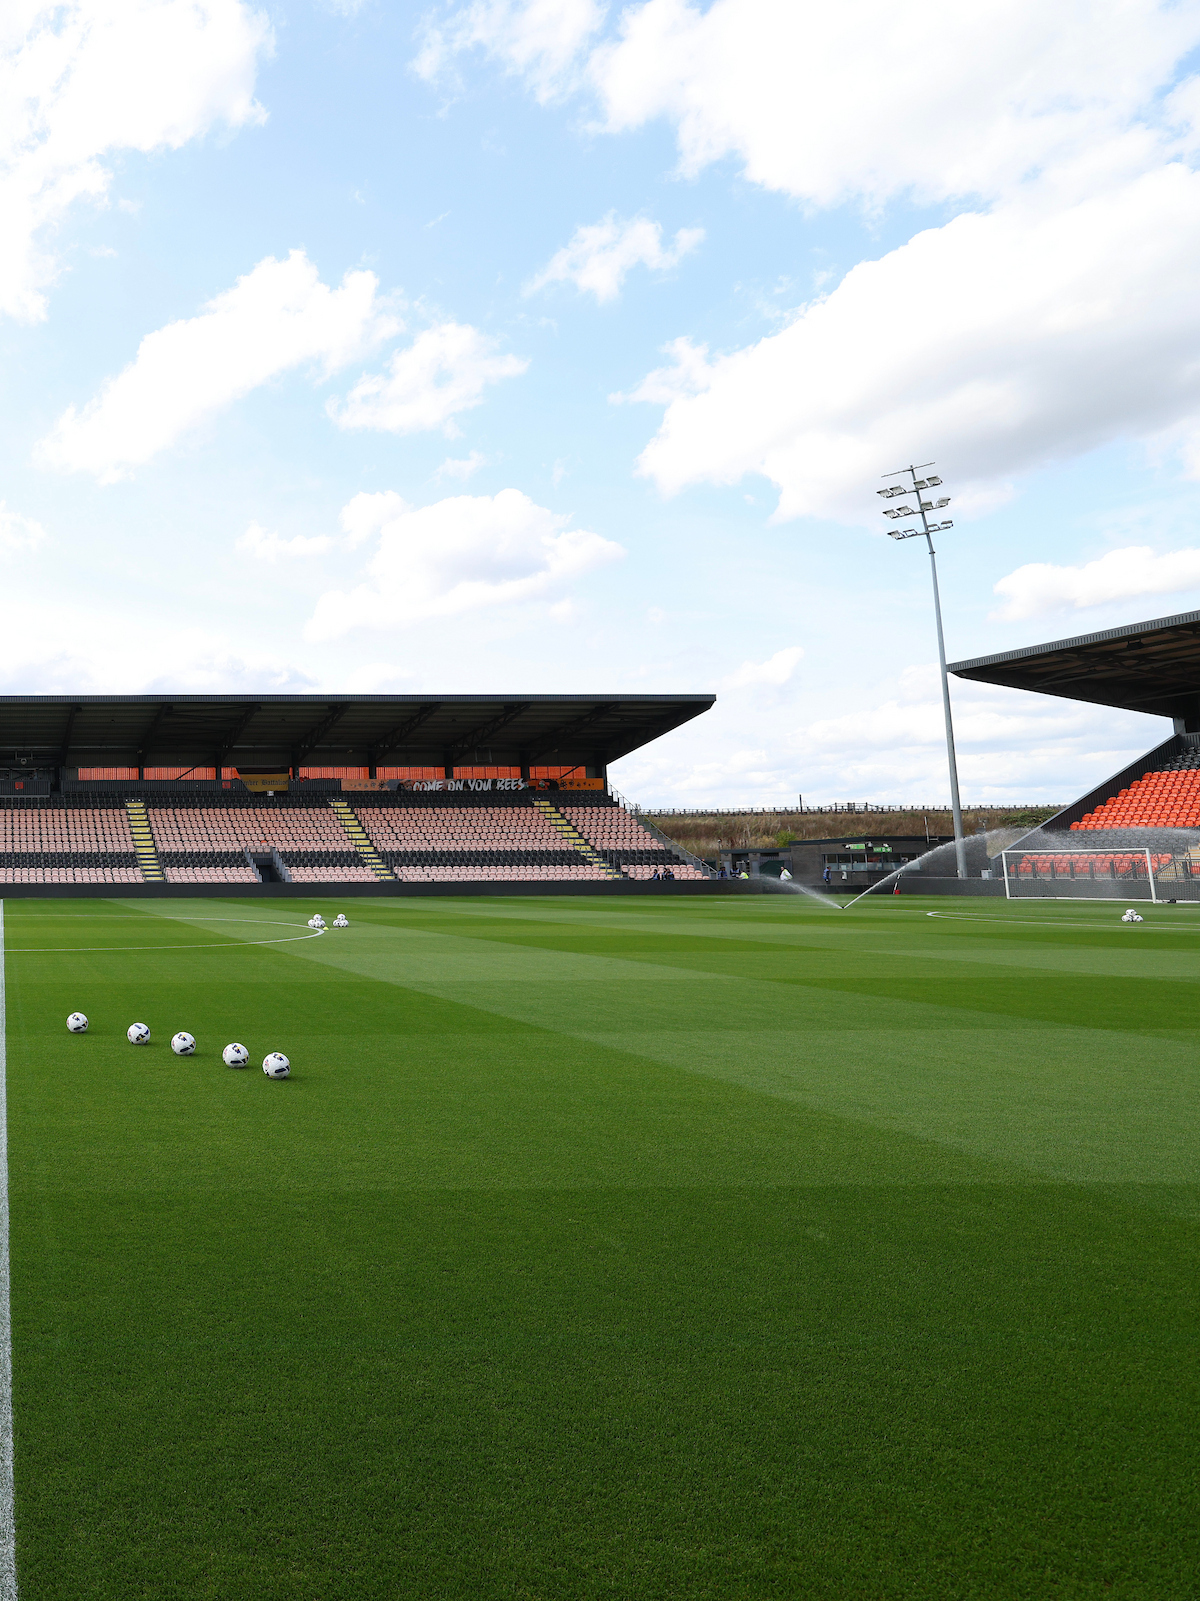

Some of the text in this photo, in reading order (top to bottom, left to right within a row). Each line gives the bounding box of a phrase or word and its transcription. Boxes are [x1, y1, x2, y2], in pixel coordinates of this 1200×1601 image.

[413, 778, 525, 791] COME ON YOU BEES
